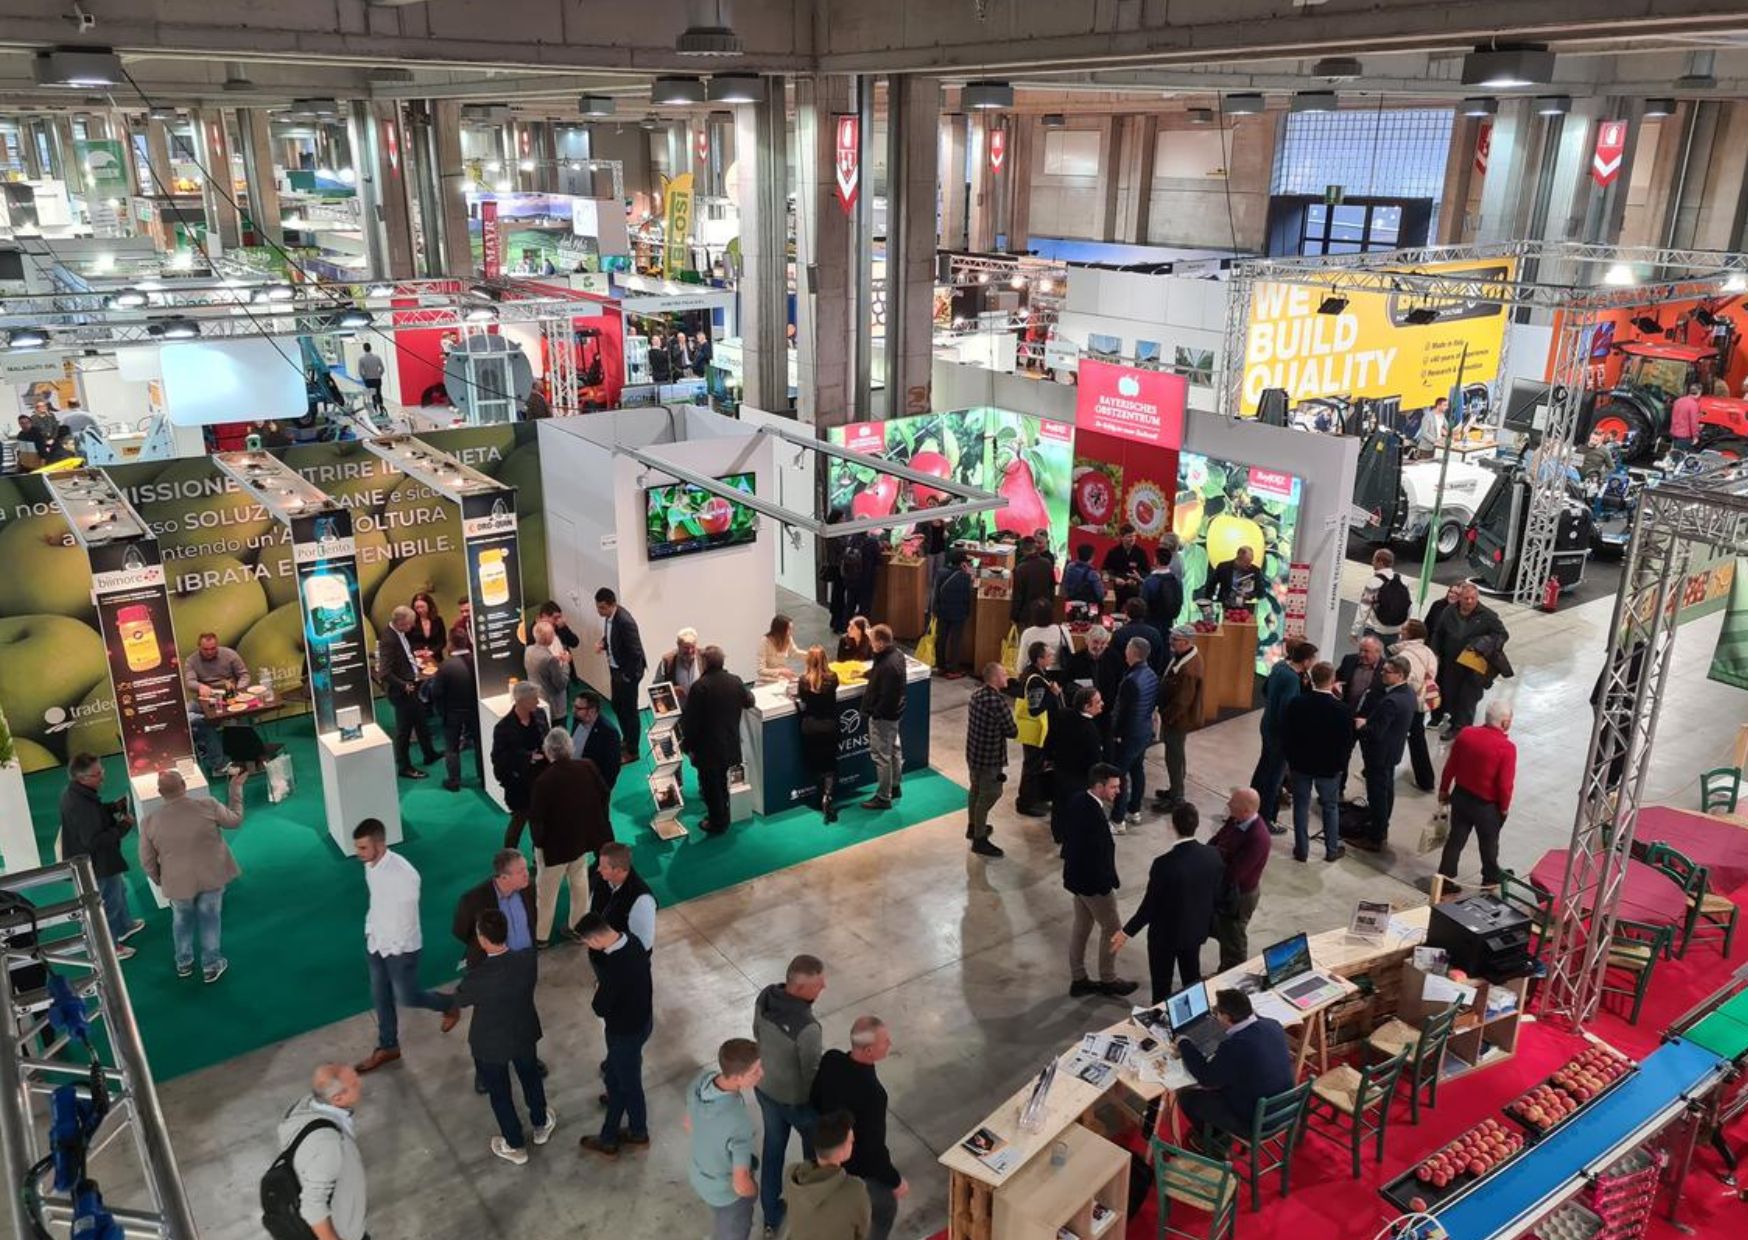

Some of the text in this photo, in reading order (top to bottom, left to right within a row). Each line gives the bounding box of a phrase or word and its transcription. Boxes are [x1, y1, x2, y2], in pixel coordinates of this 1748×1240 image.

[484, 219, 497, 263] MAYR
[1255, 281, 1310, 320] WE
[1249, 312, 1358, 364] BUILD
[1243, 345, 1398, 407] QUALITY
[1095, 404, 1161, 426] OBSTZENTRUM
[1099, 395, 1158, 415] BAYERISCHES
[15, 500, 63, 519] nos
[299, 460, 374, 484] TRIRE
[454, 445, 503, 465] NETA
[390, 490, 402, 503] e
[162, 536, 241, 562] ntendo
[279, 560, 294, 577] E
[838, 733, 870, 753] VENS
